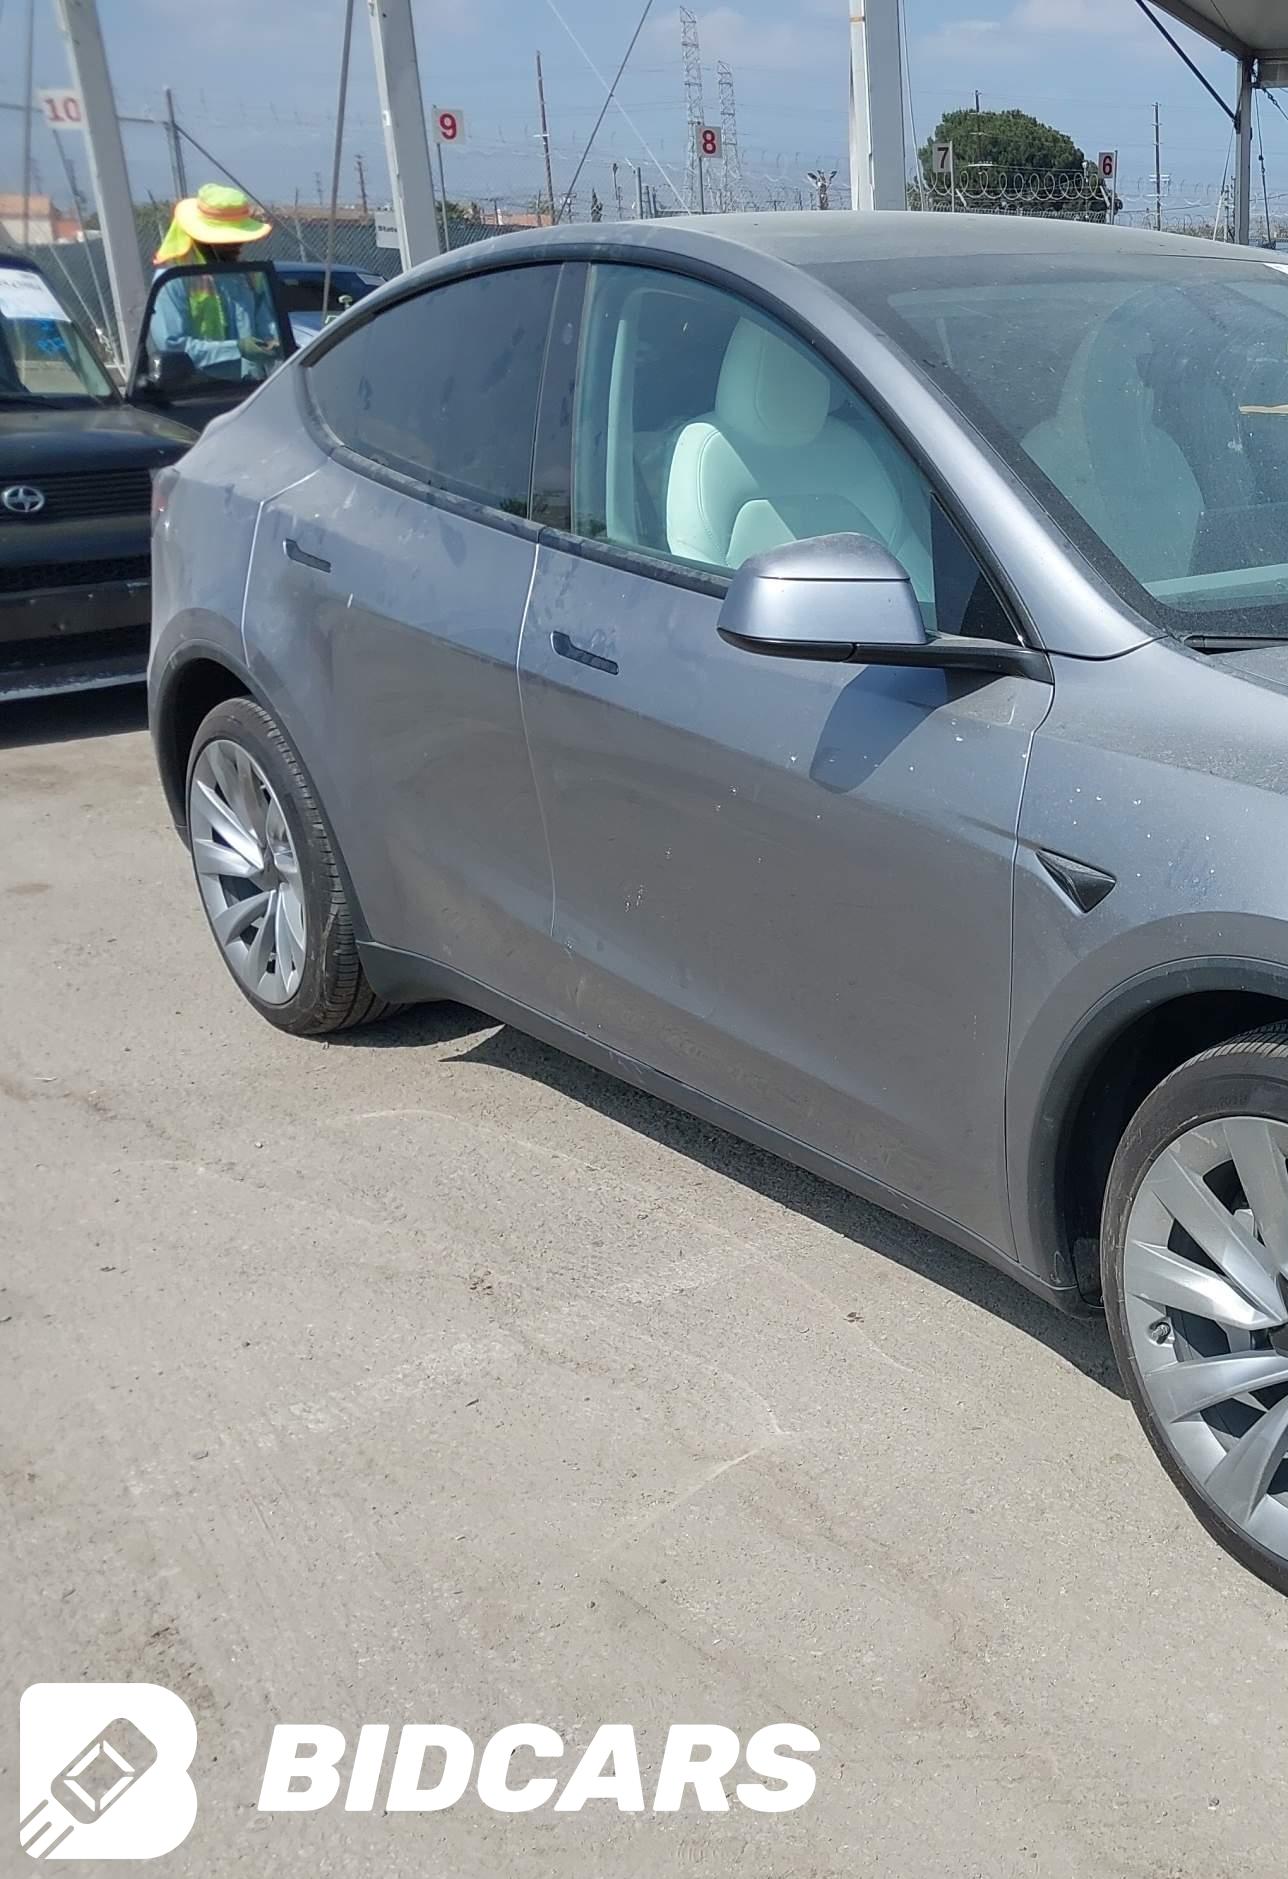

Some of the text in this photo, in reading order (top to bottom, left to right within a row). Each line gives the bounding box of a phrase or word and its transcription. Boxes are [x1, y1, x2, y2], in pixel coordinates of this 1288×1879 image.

[43, 97, 82, 122] 10
[439, 112, 457, 140] 9
[702, 129, 717, 155] 8
[937, 146, 949, 169] 7
[1102, 155, 1113, 176] 6
